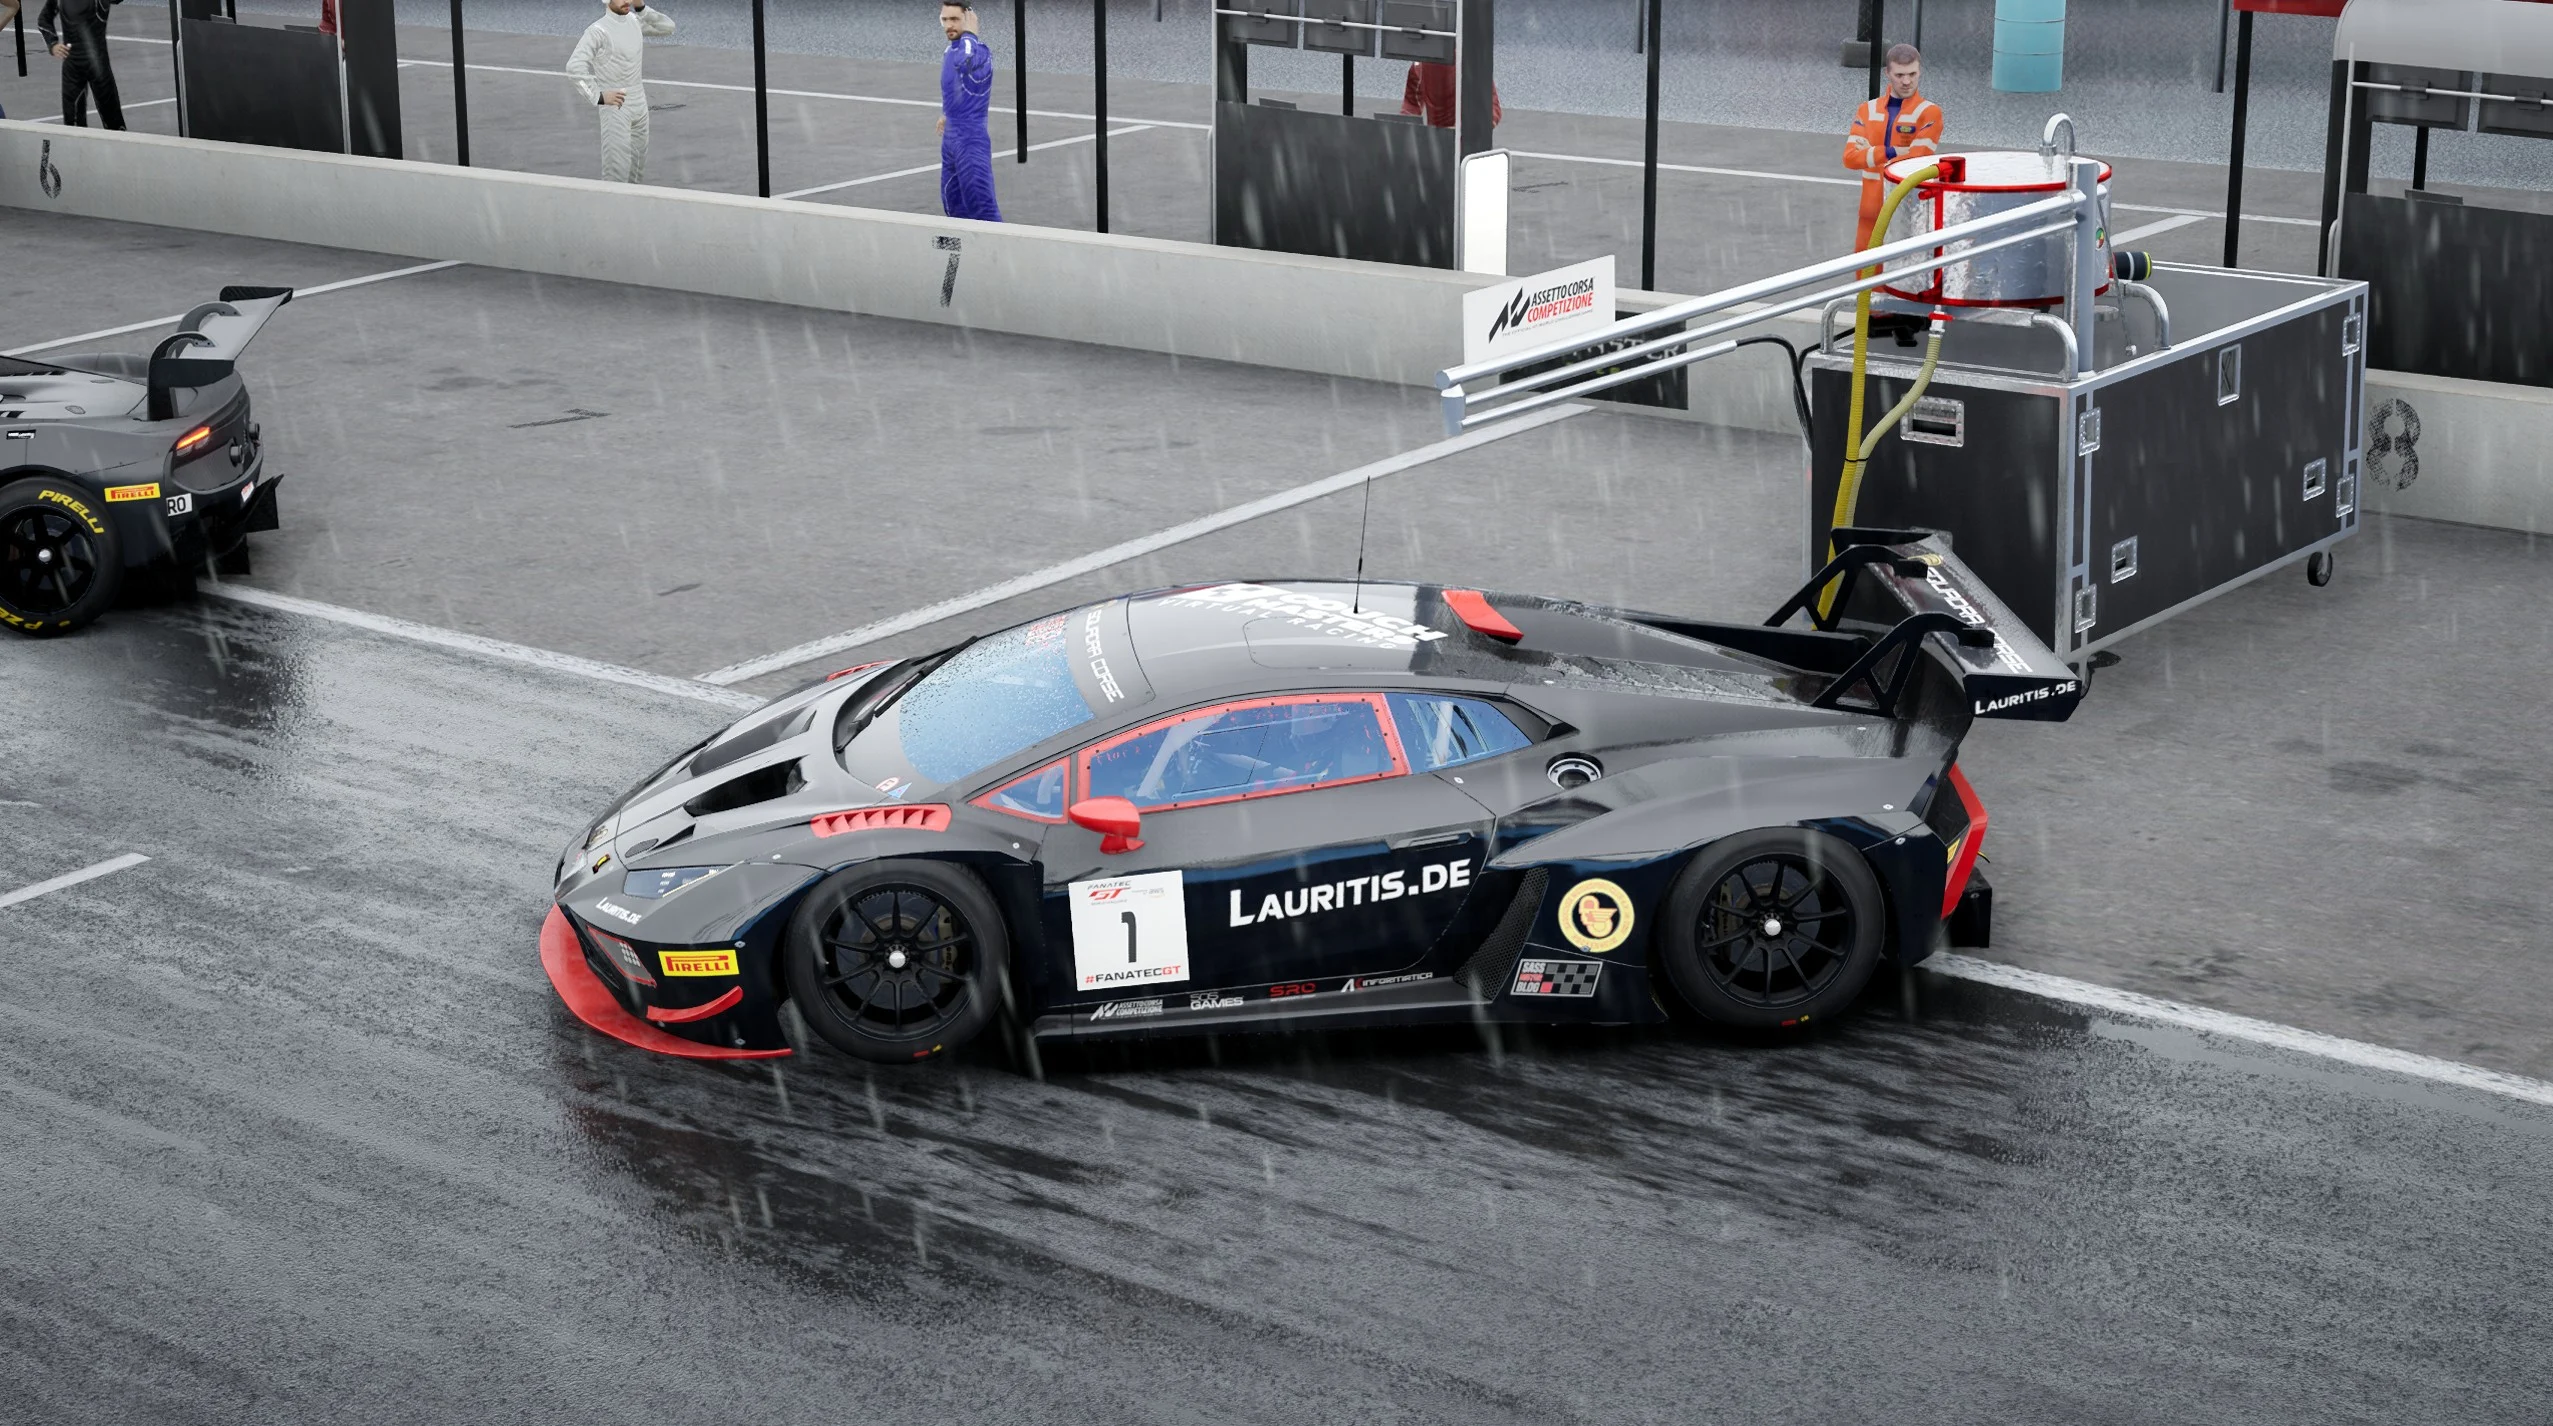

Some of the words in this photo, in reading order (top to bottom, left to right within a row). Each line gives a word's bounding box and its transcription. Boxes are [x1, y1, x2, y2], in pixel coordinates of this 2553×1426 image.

[40, 139, 62, 199] 6
[932, 235, 962, 308] 7
[1531, 285, 1566, 307] ASSETTO
[1567, 277, 1595, 299] CORSA
[1527, 292, 1594, 323] COMPETIZIONE
[2365, 398, 2421, 492] 8
[38, 489, 105, 534] PIRELLI
[110, 485, 155, 500] PIRELLI
[1279, 592, 1449, 642] COUCH
[1926, 566, 1986, 628] QUADRA
[1157, 598, 1273, 620] VIRTUAL
[1286, 616, 1398, 650] RACING
[1242, 598, 1420, 645] MASTERS
[1090, 657, 1125, 703] CORSE
[1087, 880, 1132, 890] FANATEC
[1229, 858, 1472, 928] LAURITIS.DE
[1121, 910, 1137, 963] 1
[664, 955, 730, 972] PIRELLI
[1085, 965, 1181, 984] #FANATECGT
[1190, 997, 1244, 1011] GAMES
